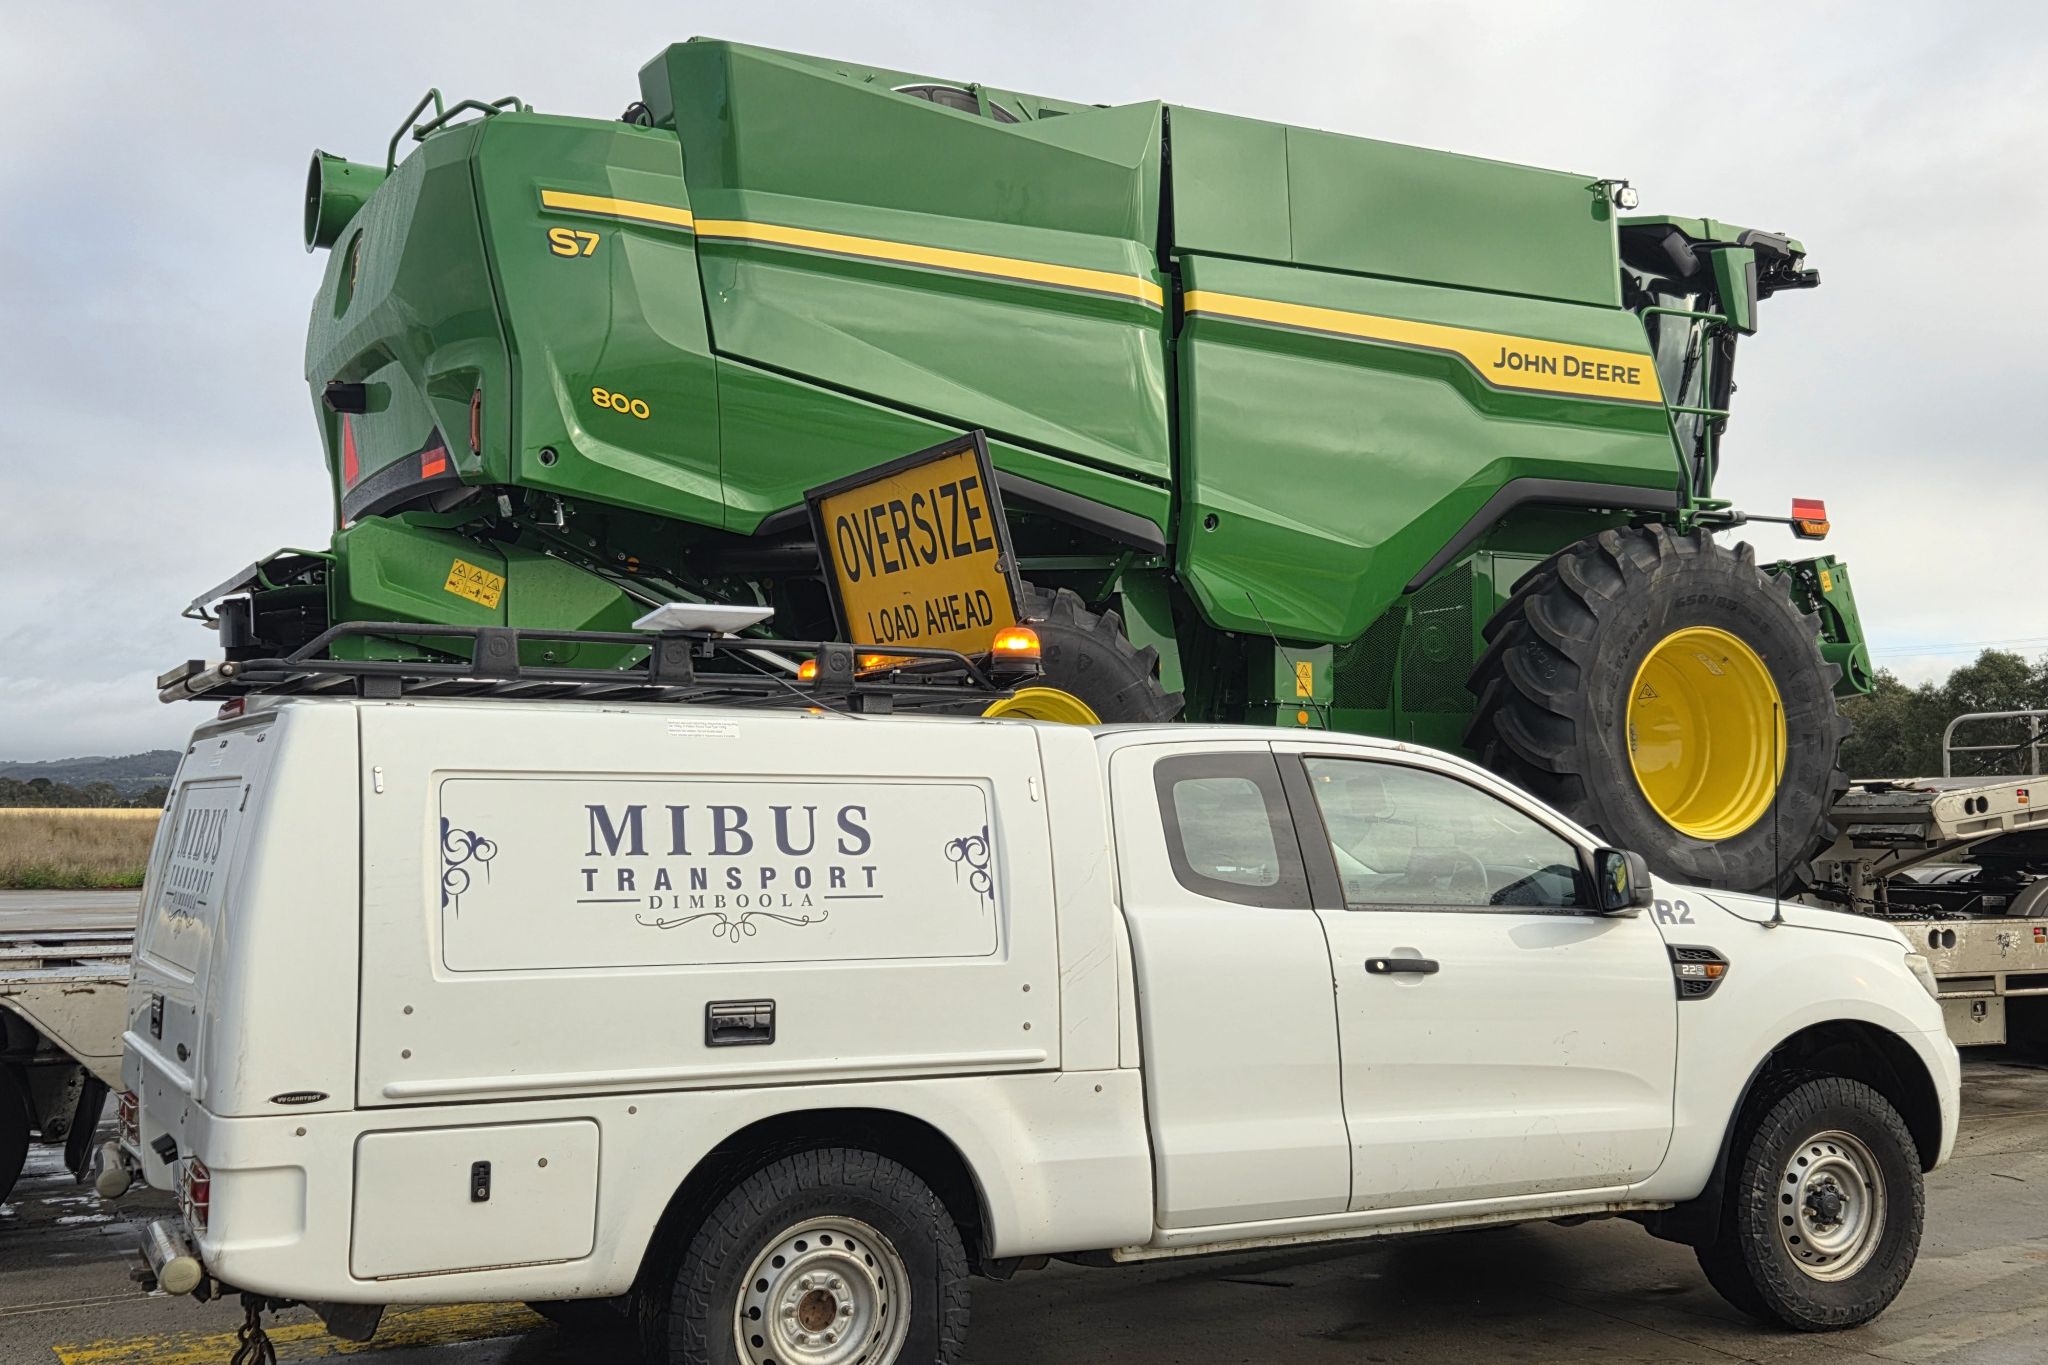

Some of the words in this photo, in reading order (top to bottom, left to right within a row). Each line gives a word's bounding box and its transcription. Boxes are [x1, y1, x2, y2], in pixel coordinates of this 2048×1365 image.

[548, 227, 600, 257] S7
[1493, 347, 1557, 375] JOHN
[1563, 355, 1641, 385] DEERE
[592, 387, 650, 419] 800
[836, 475, 994, 583] OVERSIZE
[868, 604, 920, 644] LOAD
[925, 589, 994, 636] AHEAD
[177, 808, 229, 865] MIBUS
[584, 803, 872, 857] MIBUS
[580, 865, 878, 892] TRANSPORT
[648, 893, 815, 910] DIMBOOLA
[1654, 899, 1696, 925] R2
